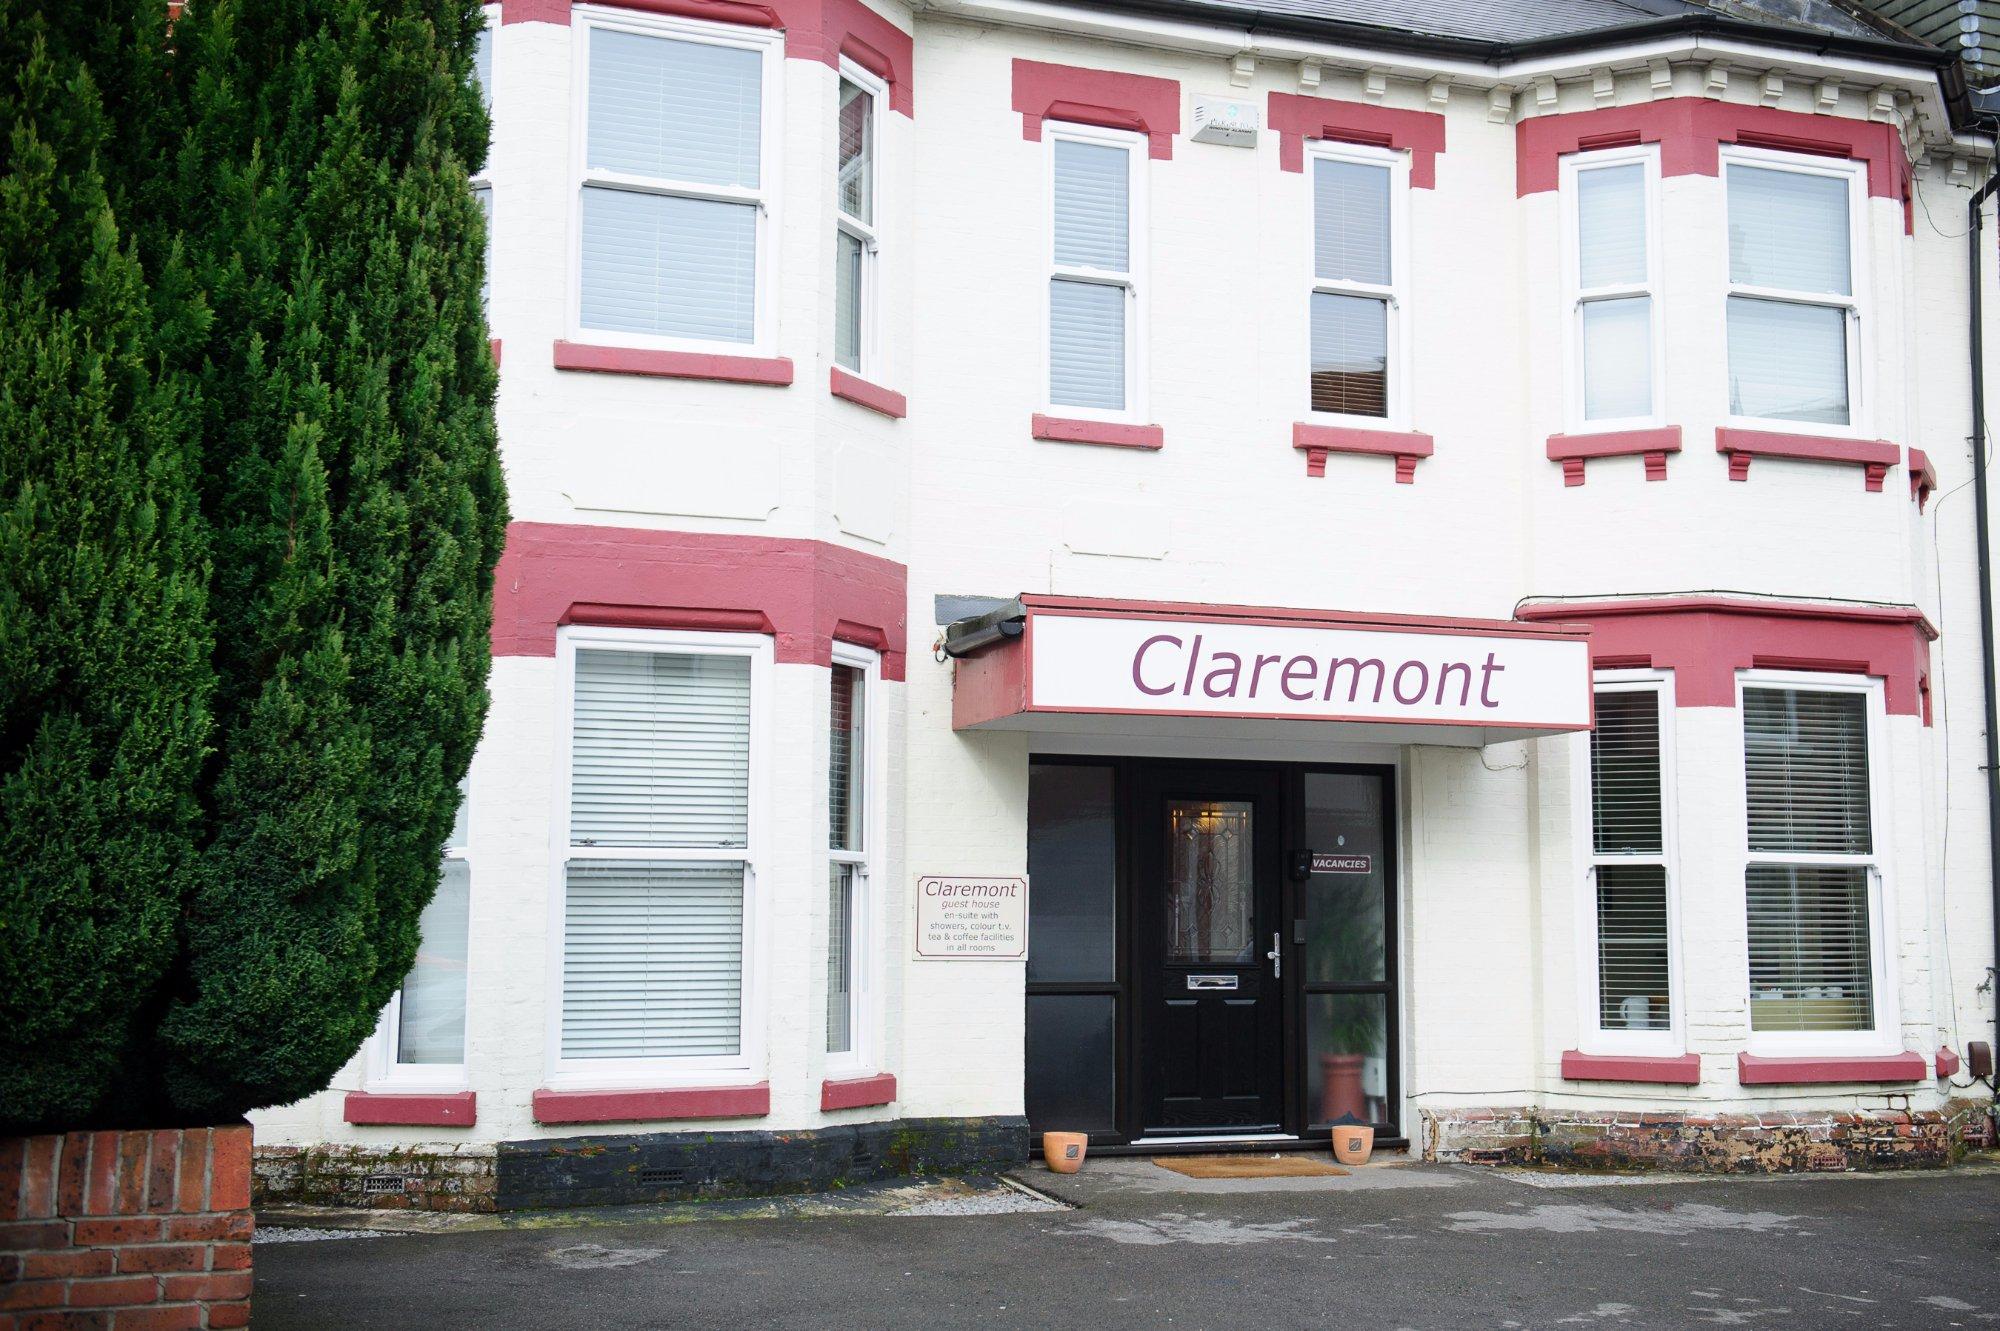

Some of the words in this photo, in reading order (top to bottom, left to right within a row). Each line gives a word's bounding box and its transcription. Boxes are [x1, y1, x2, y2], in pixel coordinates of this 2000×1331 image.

[1132, 634, 1505, 709] Claremont
[1313, 859, 1367, 868] VACANCIES
[926, 881, 1017, 897] Claremont
[941, 900, 969, 909] guest
[971, 900, 1000, 908] house
[930, 923, 967, 931] showers,
[944, 933, 951, 941] &
[953, 933, 979, 941] coffee
[980, 933, 1015, 941] facilities
